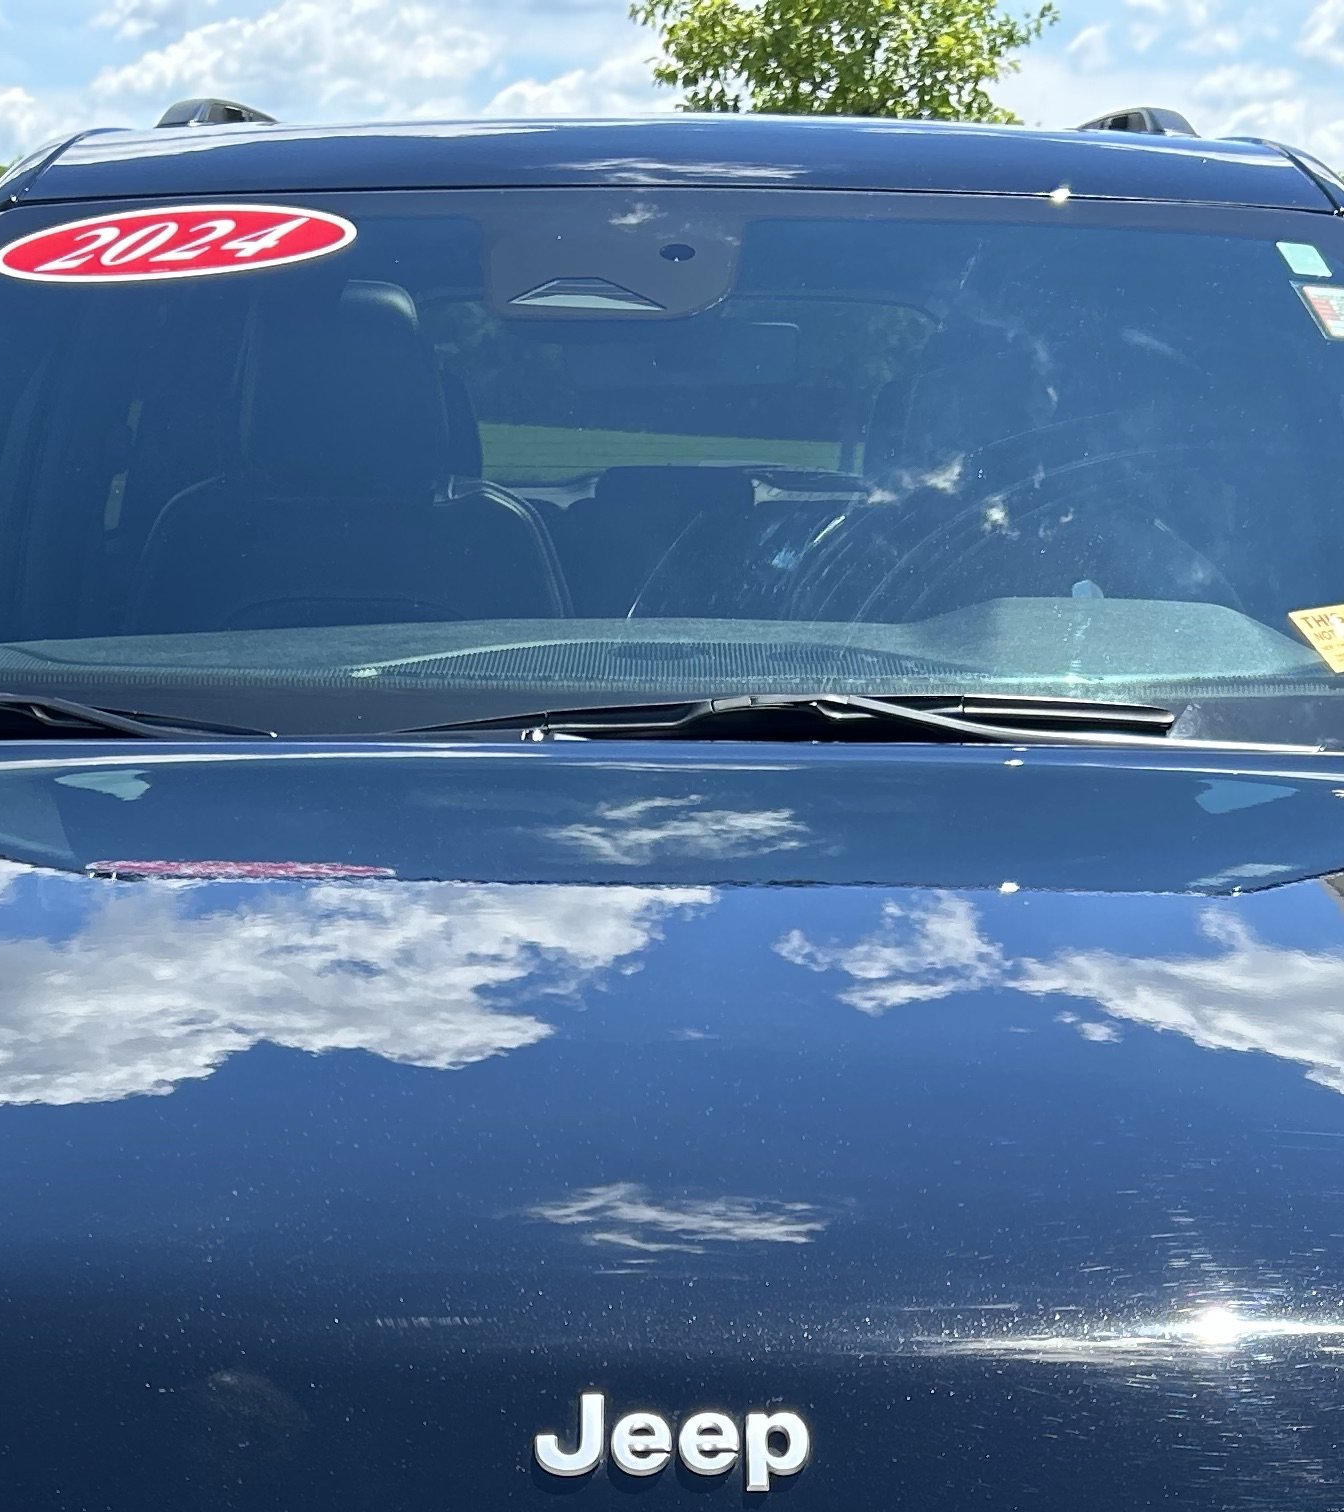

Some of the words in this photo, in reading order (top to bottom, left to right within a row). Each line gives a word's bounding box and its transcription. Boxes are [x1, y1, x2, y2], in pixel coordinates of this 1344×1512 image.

[33, 216, 311, 273] 2024
[1314, 629, 1337, 641] NOT
[534, 1391, 810, 1493] Jeep
